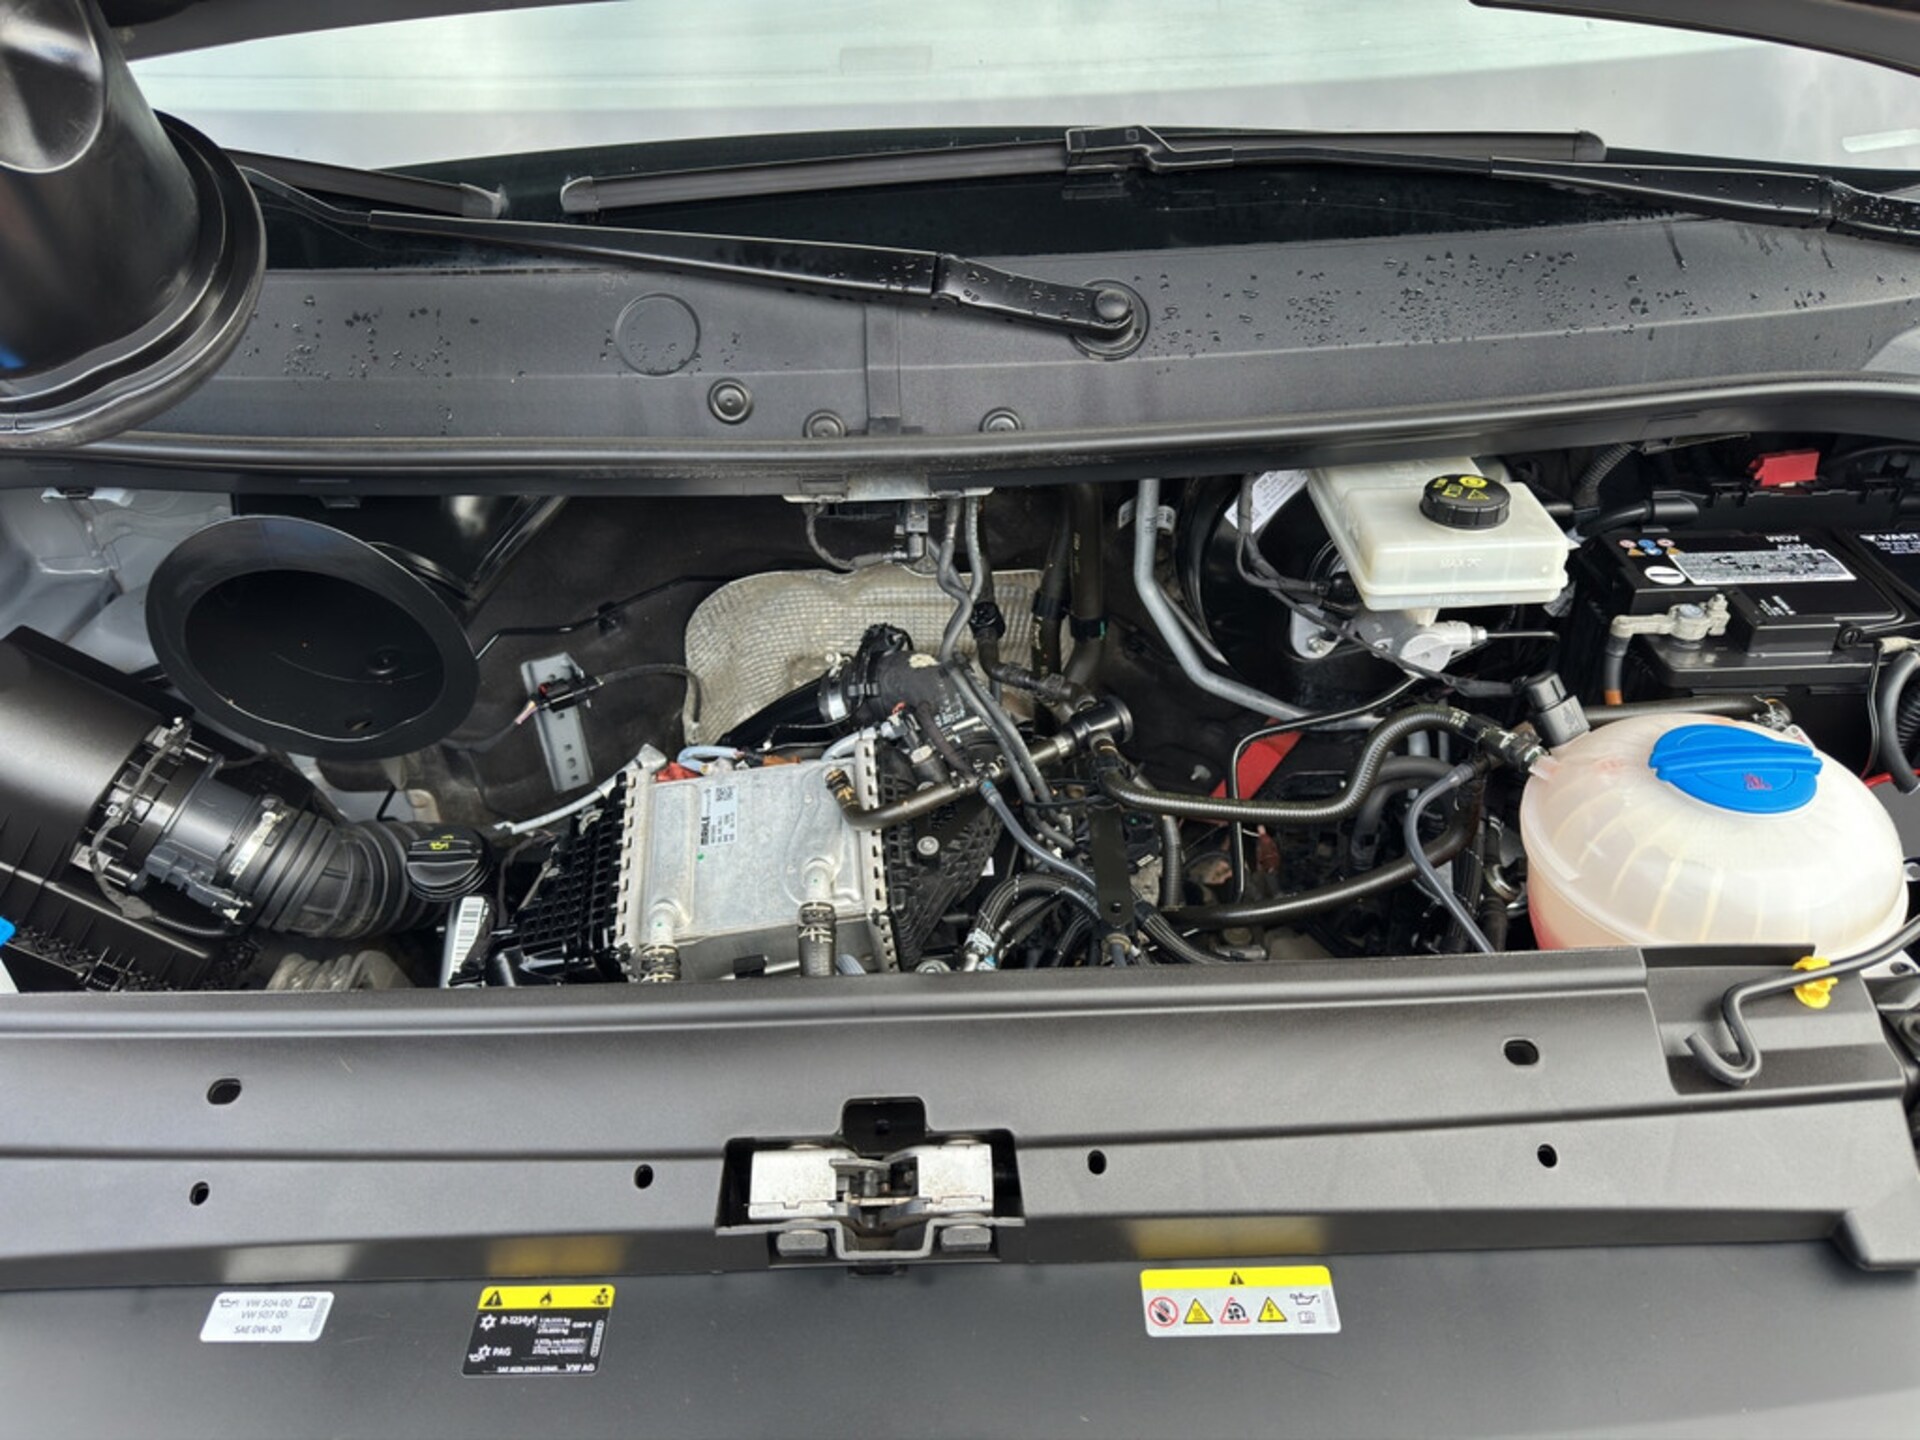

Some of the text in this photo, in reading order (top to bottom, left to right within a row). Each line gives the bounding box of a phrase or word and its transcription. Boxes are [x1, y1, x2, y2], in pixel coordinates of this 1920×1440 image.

[246, 1299, 293, 1308] VW 504 00
[241, 1310, 288, 1319] VW 507 00
[234, 1325, 251, 1334] SAE
[493, 1347, 512, 1356] PAG
[566, 1363, 581, 1371] VW
[581, 1363, 595, 1371] AG
